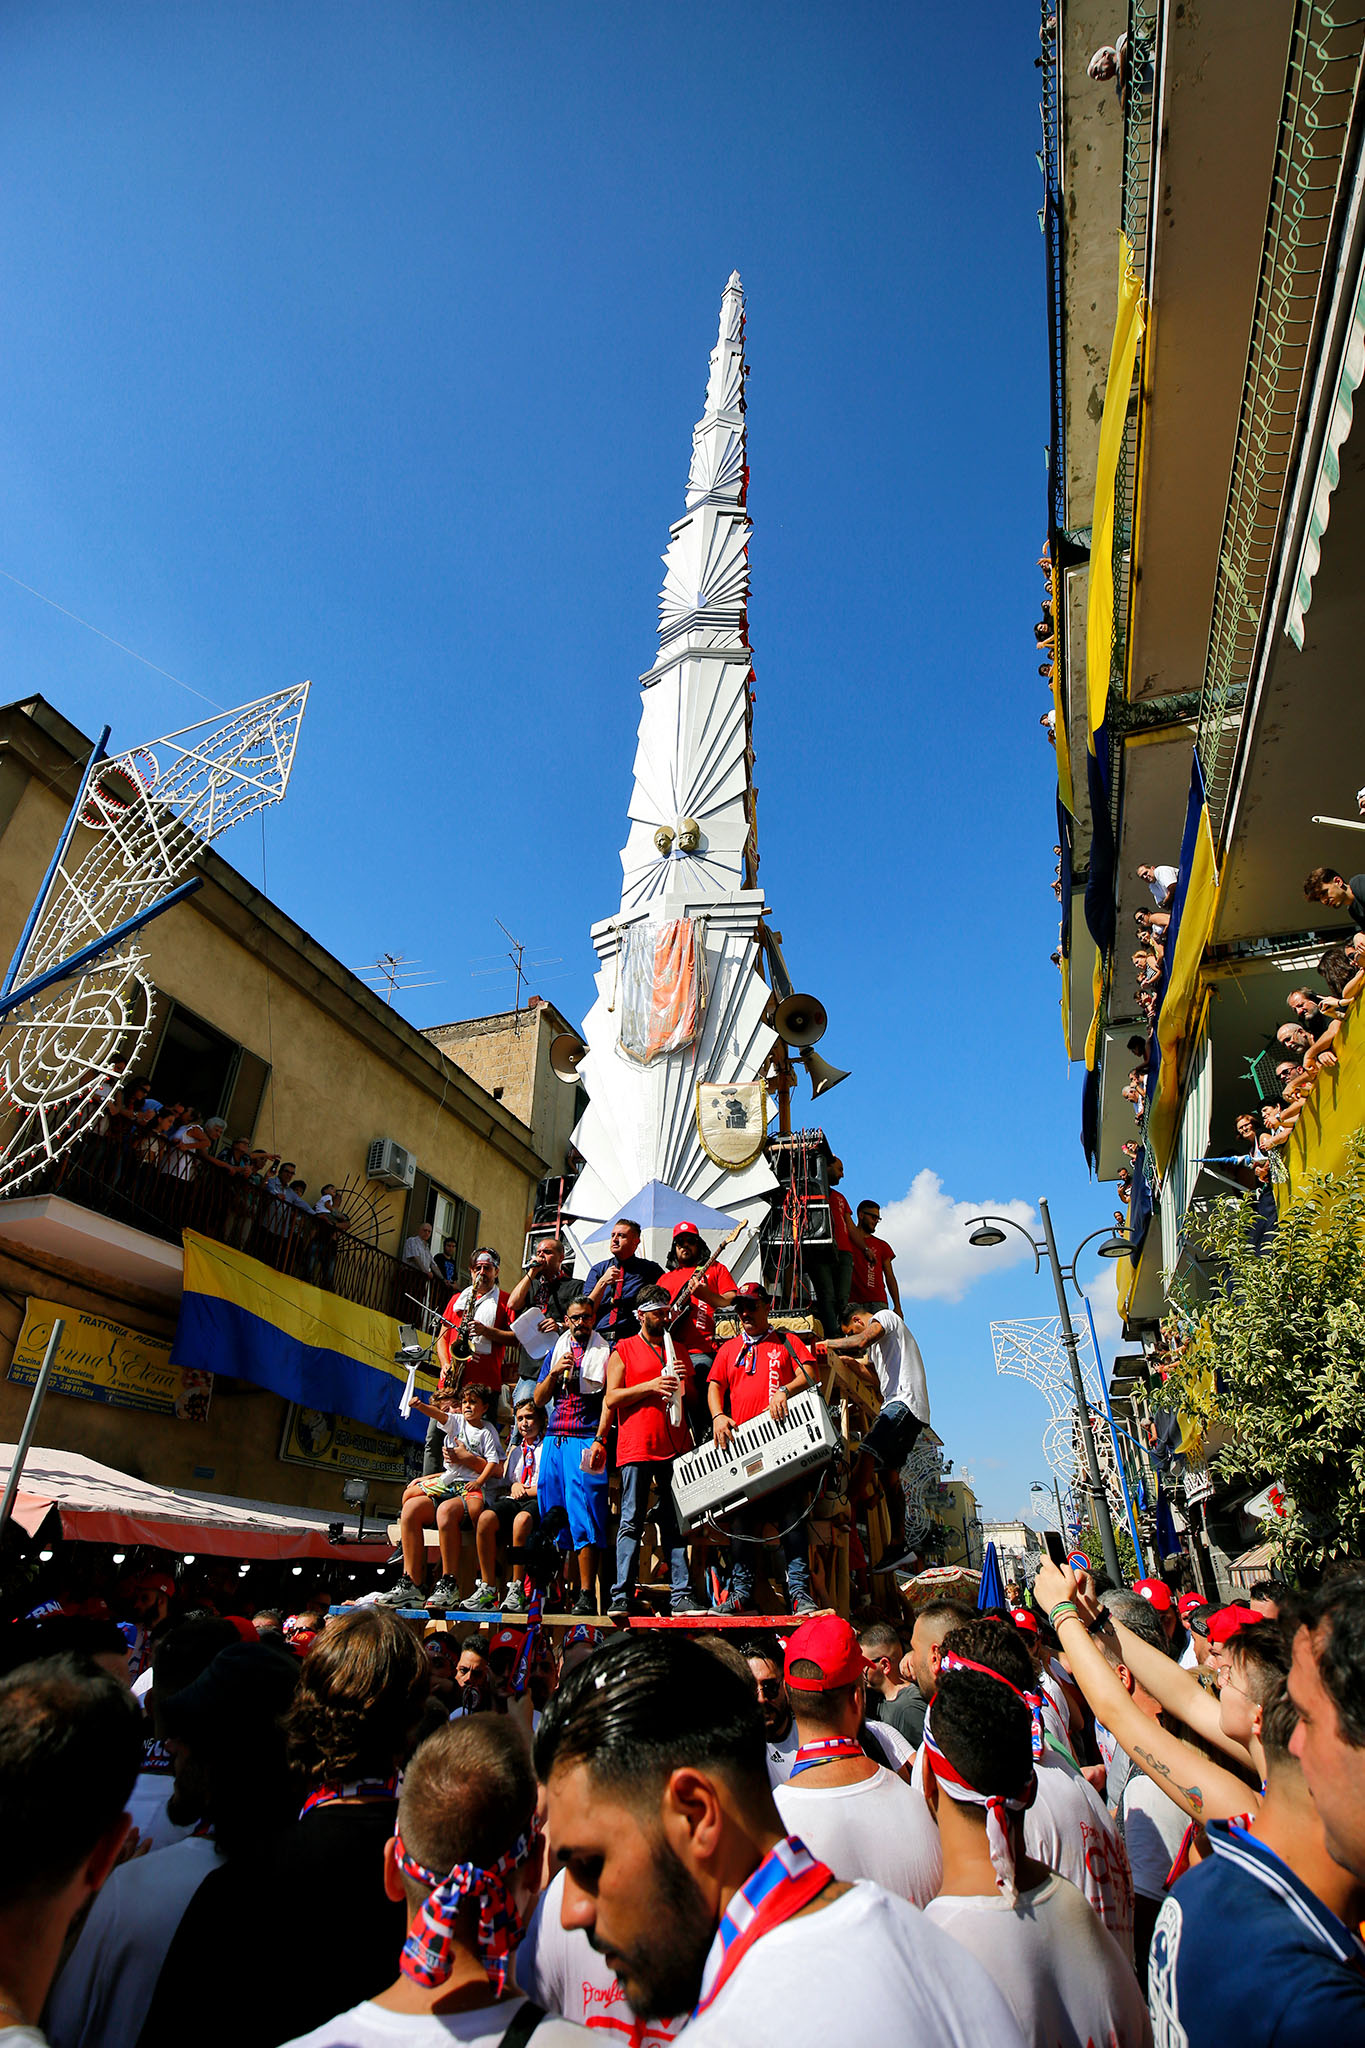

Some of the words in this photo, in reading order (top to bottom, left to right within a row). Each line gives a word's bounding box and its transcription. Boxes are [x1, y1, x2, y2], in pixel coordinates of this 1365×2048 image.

[78, 1315, 128, 1337] TRATTORIA
[119, 1350, 175, 1388] Elena
[806, 1448, 830, 1465] YAMAHA
